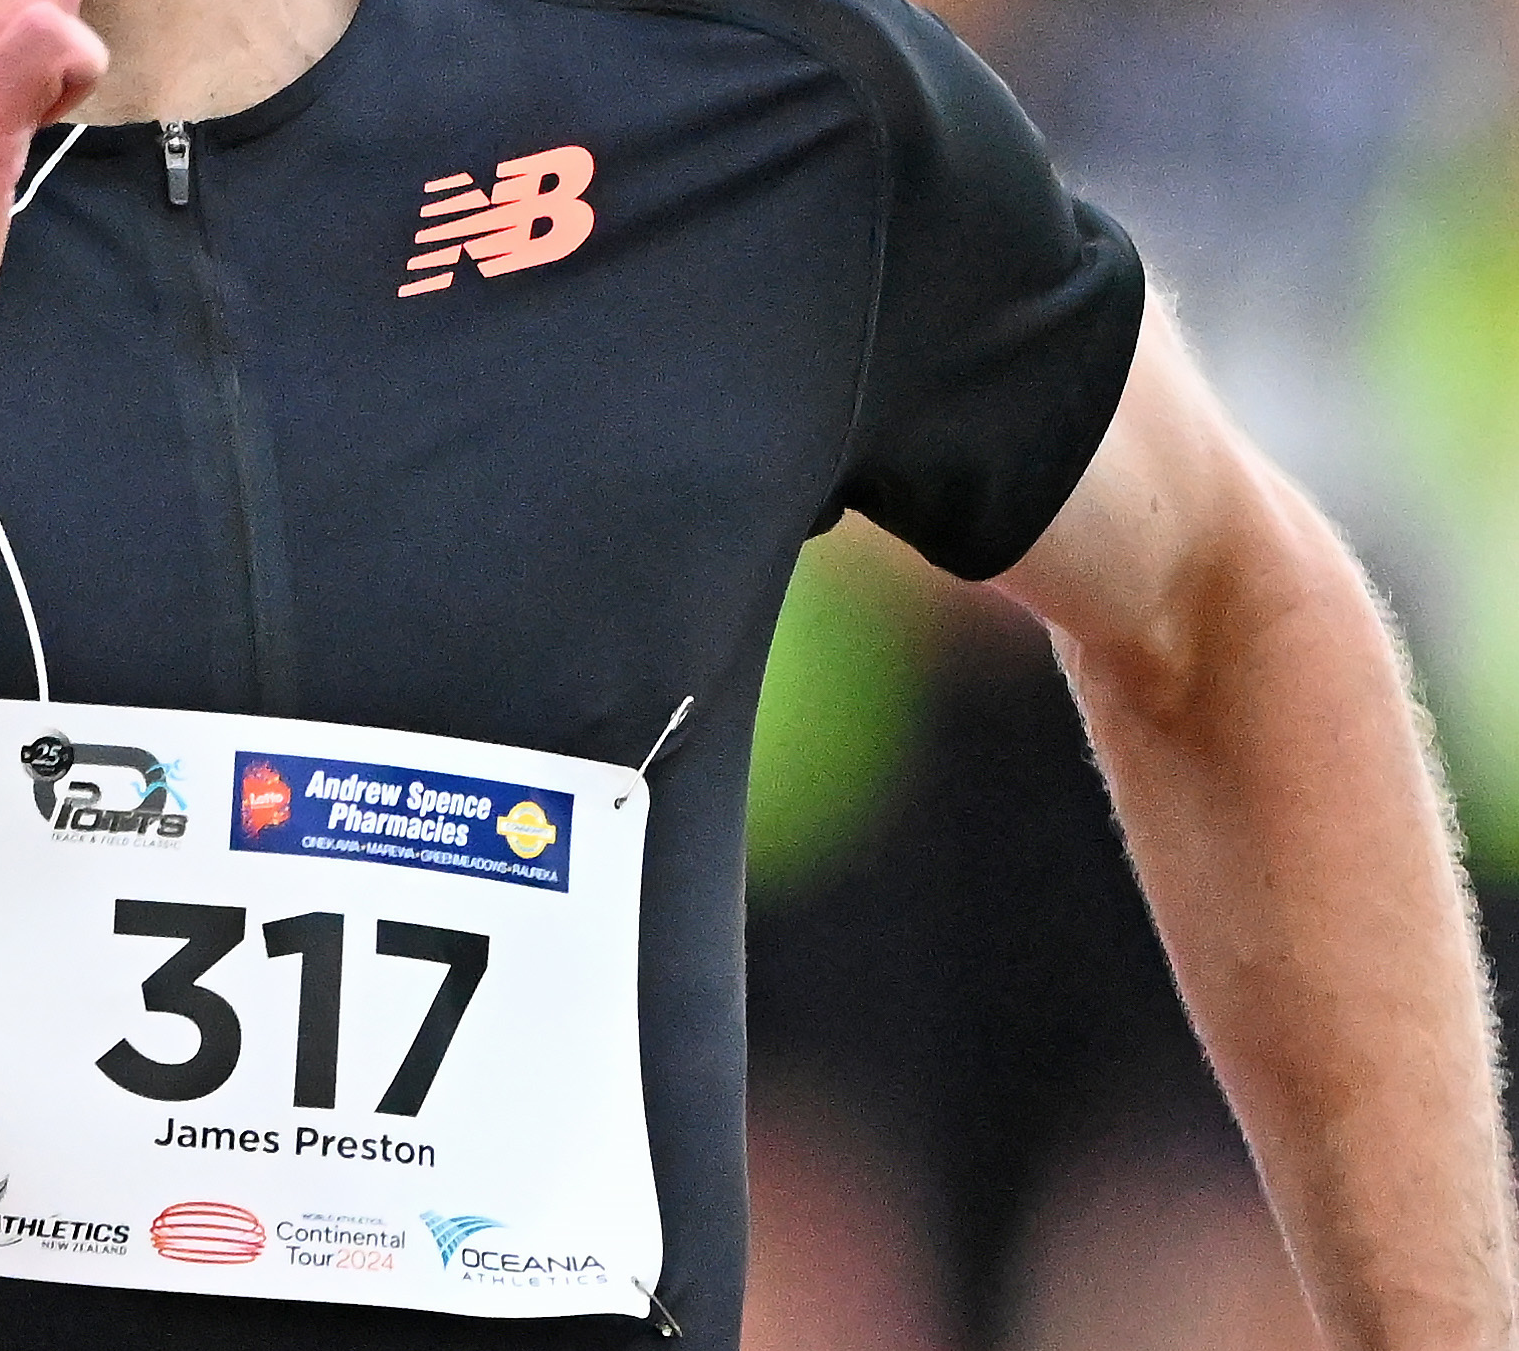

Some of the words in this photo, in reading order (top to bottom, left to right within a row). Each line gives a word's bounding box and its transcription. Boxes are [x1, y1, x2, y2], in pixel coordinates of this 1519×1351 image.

[31, 743, 63, 766] 25
[305, 770, 403, 807] Andrew
[406, 781, 492, 821] Spence
[327, 802, 470, 847] Pharmacies
[95, 899, 490, 1117] 317
[154, 1117, 280, 1154] James
[295, 1127, 435, 1167] Preston
[41, 1240, 69, 1251] NEW
[72, 1242, 128, 1256] ZEALAND
[276, 1221, 406, 1249] Continental
[286, 1245, 334, 1267] Tour
[335, 1249, 394, 1271] 2024
[462, 1248, 605, 1273] OCEANIA
[462, 1271, 608, 1288] ATHLETICS
